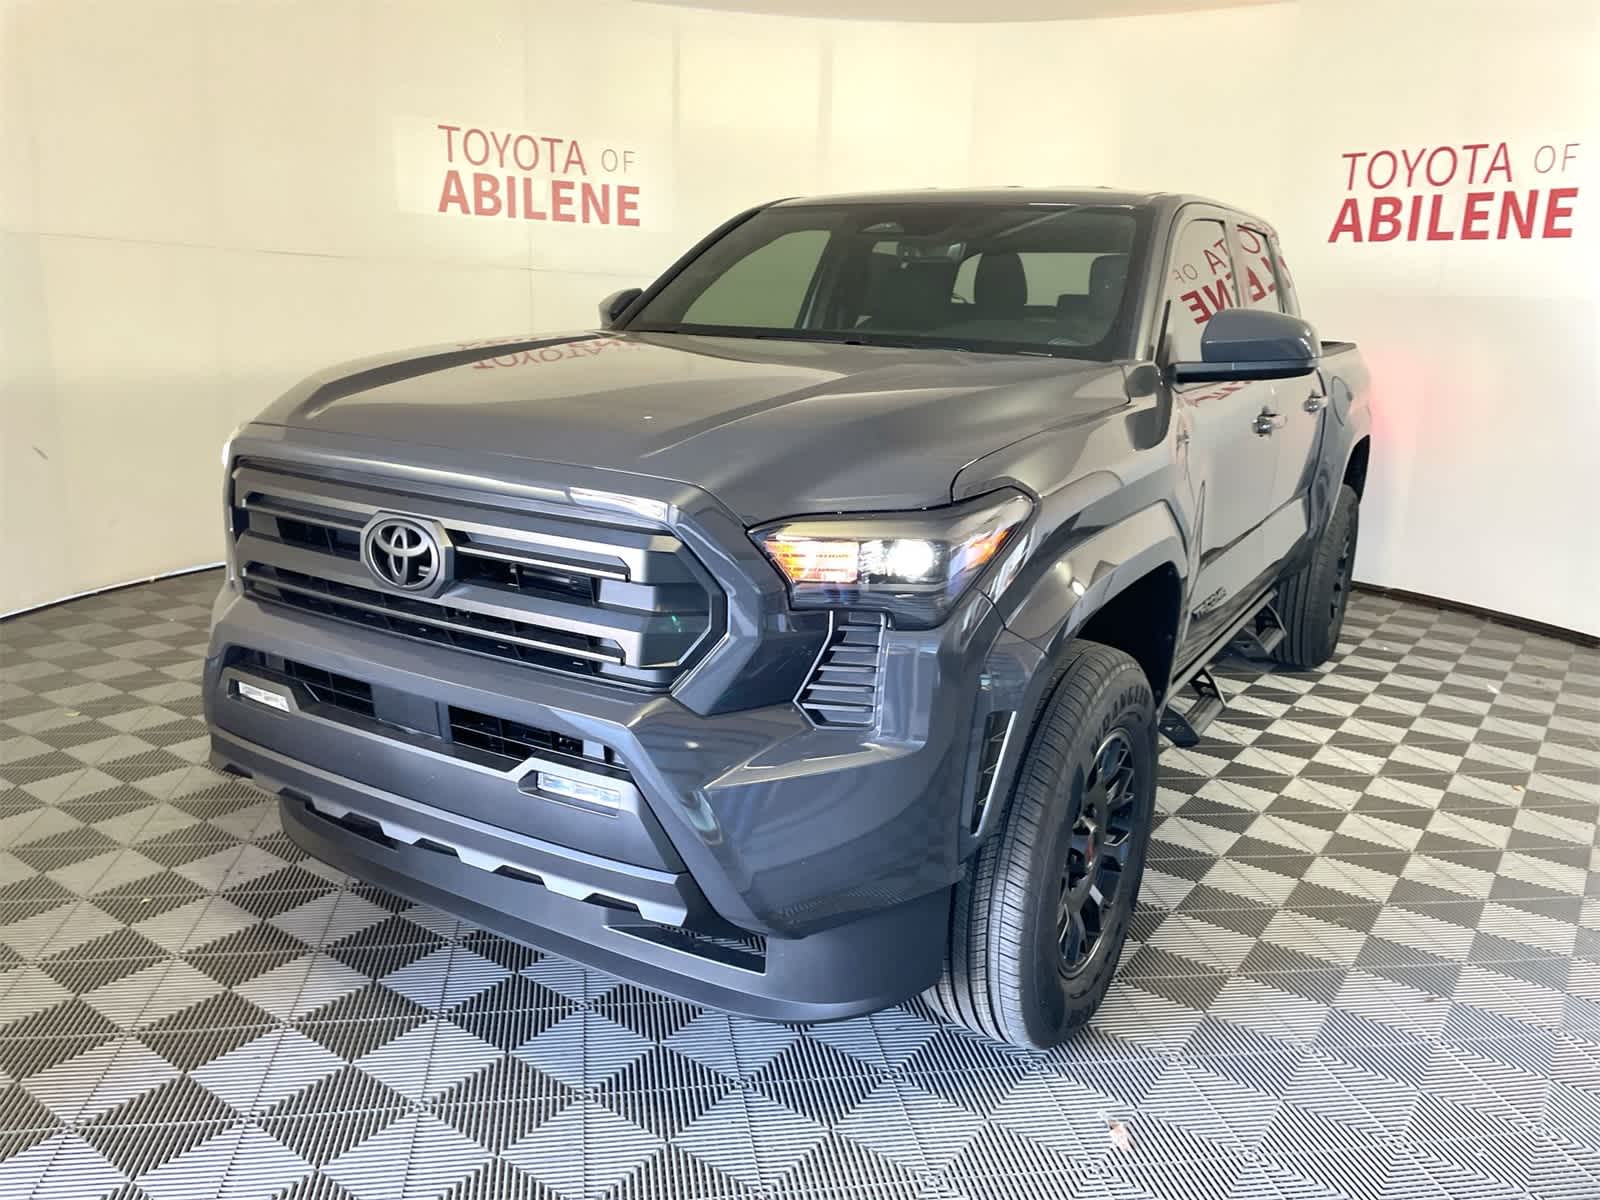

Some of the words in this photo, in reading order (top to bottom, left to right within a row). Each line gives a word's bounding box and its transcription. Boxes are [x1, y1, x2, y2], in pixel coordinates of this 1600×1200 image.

[437, 124, 587, 176] TOYOTA
[601, 148, 635, 174] OF
[1342, 142, 1513, 191] TOYOTA
[1534, 143, 1580, 174] OF
[437, 170, 641, 227] ABILENE
[1328, 187, 1579, 243] ABILENE
